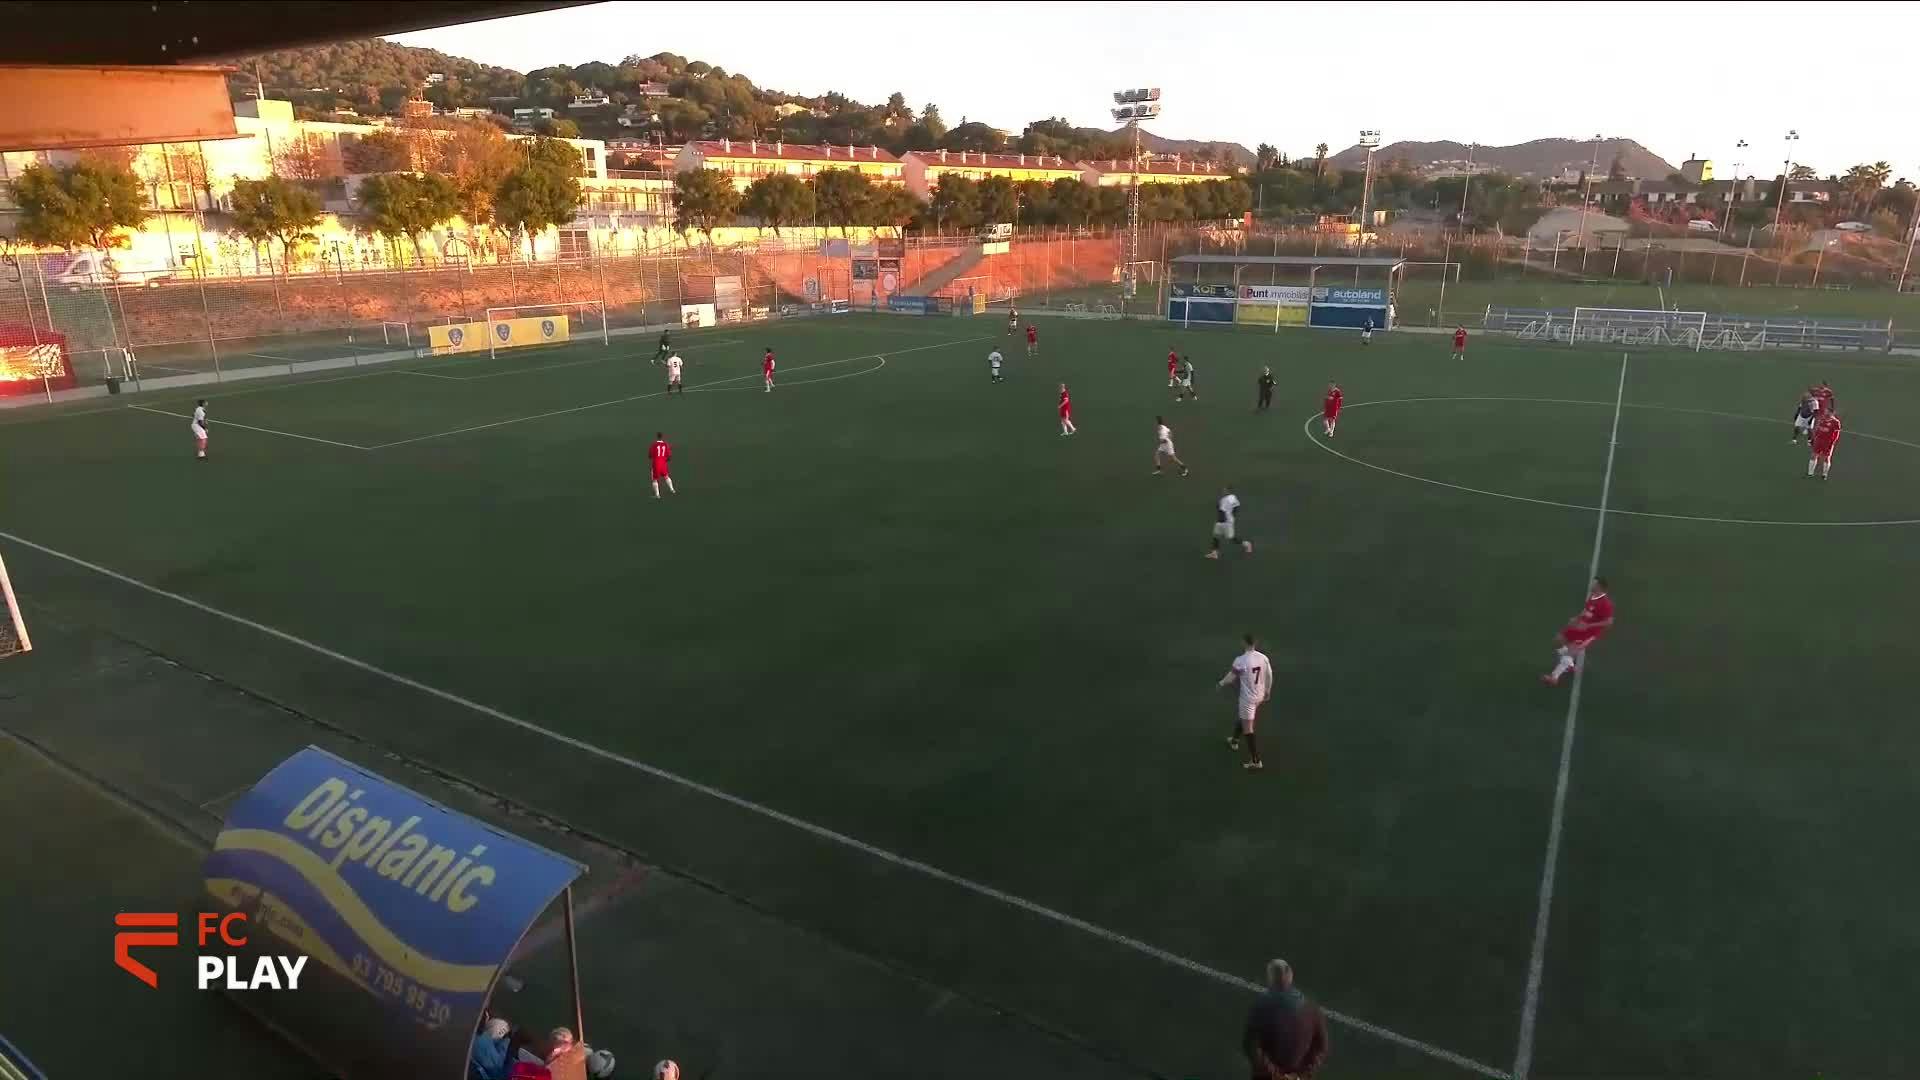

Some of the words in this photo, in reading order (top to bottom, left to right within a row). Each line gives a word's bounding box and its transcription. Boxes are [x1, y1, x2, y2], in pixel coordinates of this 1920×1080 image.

[1247, 288, 1269, 298] Punt
[1333, 289, 1381, 299] autoland
[656, 445, 666, 457] 11
[1252, 667, 1261, 685] 7
[284, 777, 496, 912] Displanic
